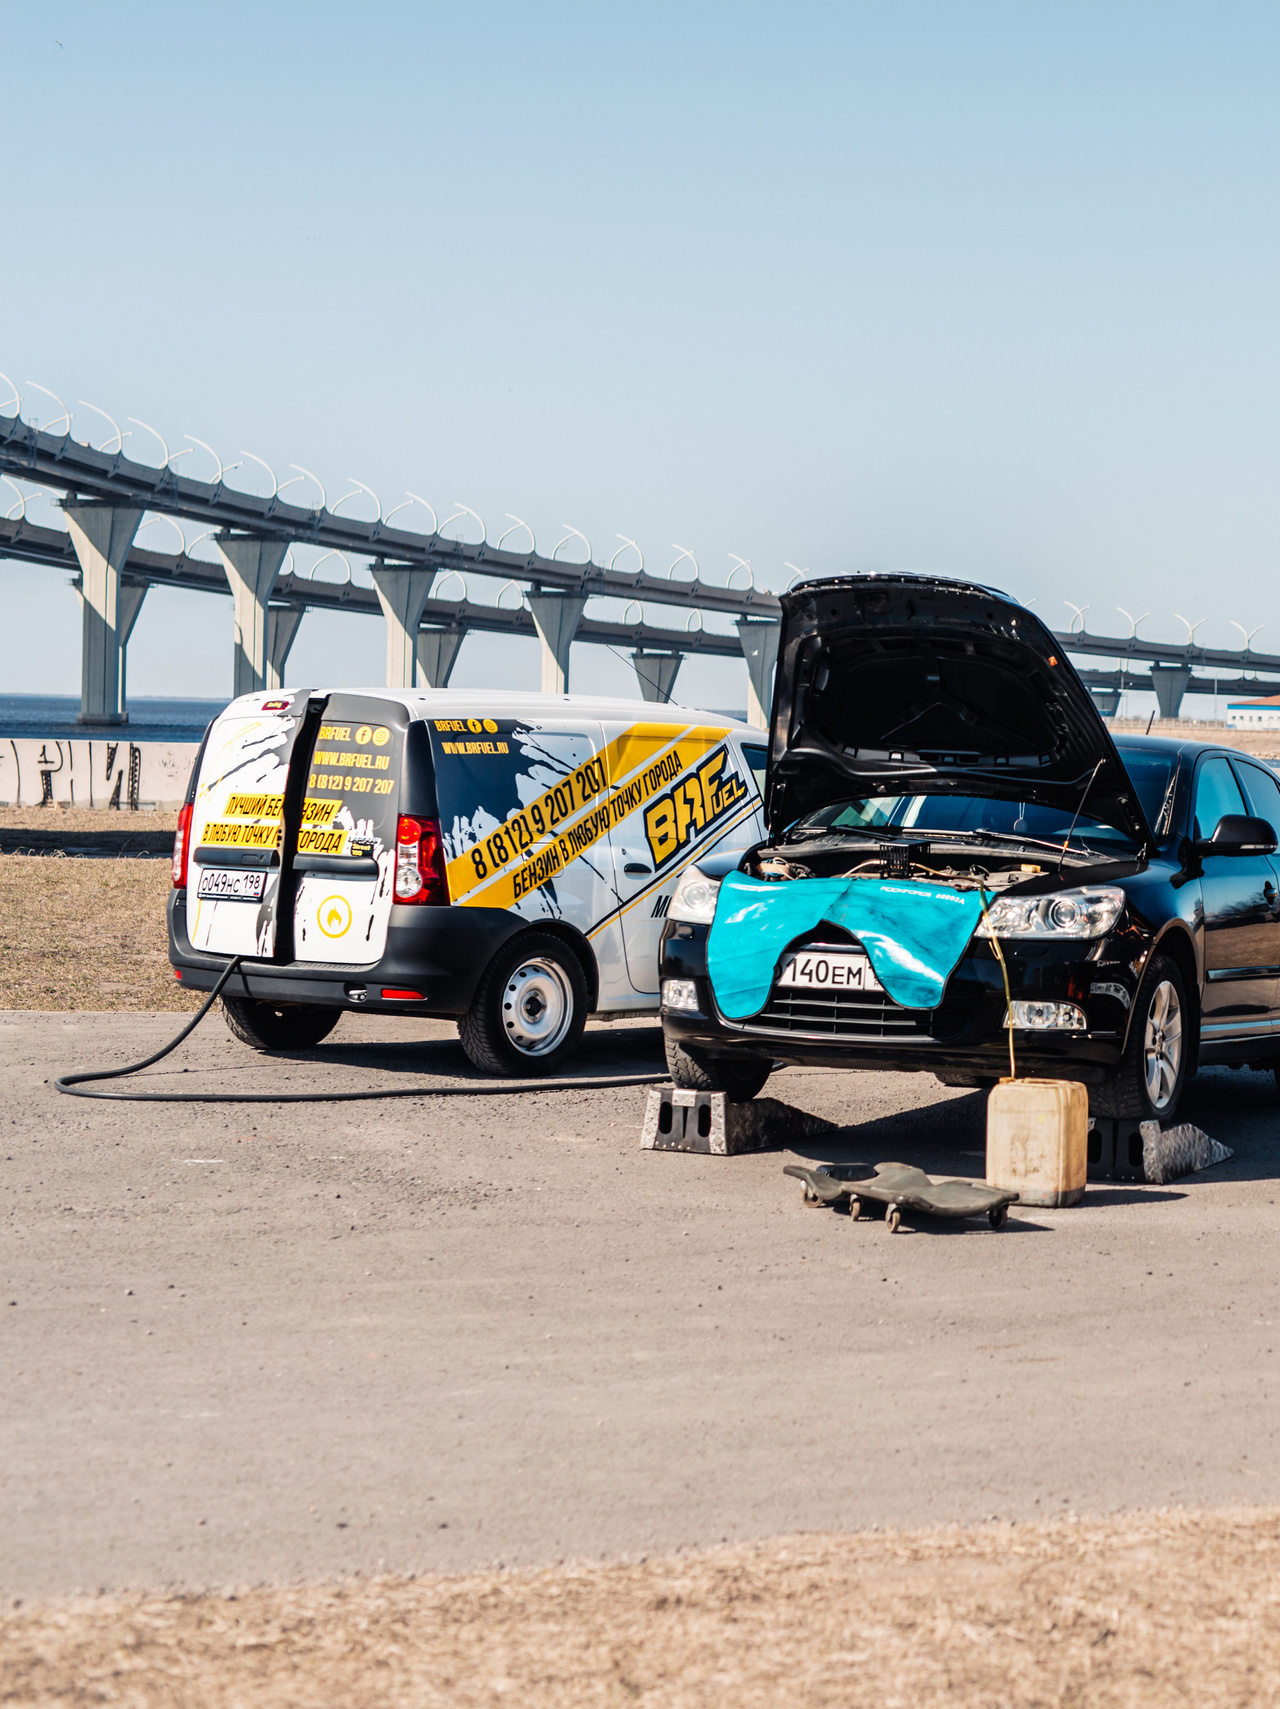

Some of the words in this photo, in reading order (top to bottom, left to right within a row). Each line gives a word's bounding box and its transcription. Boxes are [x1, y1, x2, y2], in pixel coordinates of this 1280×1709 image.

[318, 726, 351, 741] BRFUEL
[434, 720, 467, 732] BRFUEL
[442, 742, 509, 754] WWW.BRFUEL.RU
[313, 751, 390, 770] WWW.BRFUEL.RU
[308, 773, 317, 788] 8
[317, 774, 344, 790] (812)
[344, 776, 352, 791] 9
[352, 777, 374, 792] 207
[373, 778, 395, 794] 207
[226, 794, 268, 815] ЛУЧШИЙ
[471, 848, 488, 879] 8
[486, 814, 533, 868] (812)
[531, 804, 546, 834] 9
[545, 780, 576, 826] 207
[577, 757, 607, 802] 207
[513, 843, 560, 898] БЕНЗИН
[559, 839, 569, 862] В
[567, 806, 610, 855] ЛЮБУЮ
[610, 778, 642, 822] ТОЧКУ
[643, 750, 683, 796] ГОРОДА
[203, 824, 210, 841] В
[209, 824, 242, 842] ЛЮБУЮ
[242, 825, 274, 844] ТОЧКУ
[244, 874, 260, 889] 198
